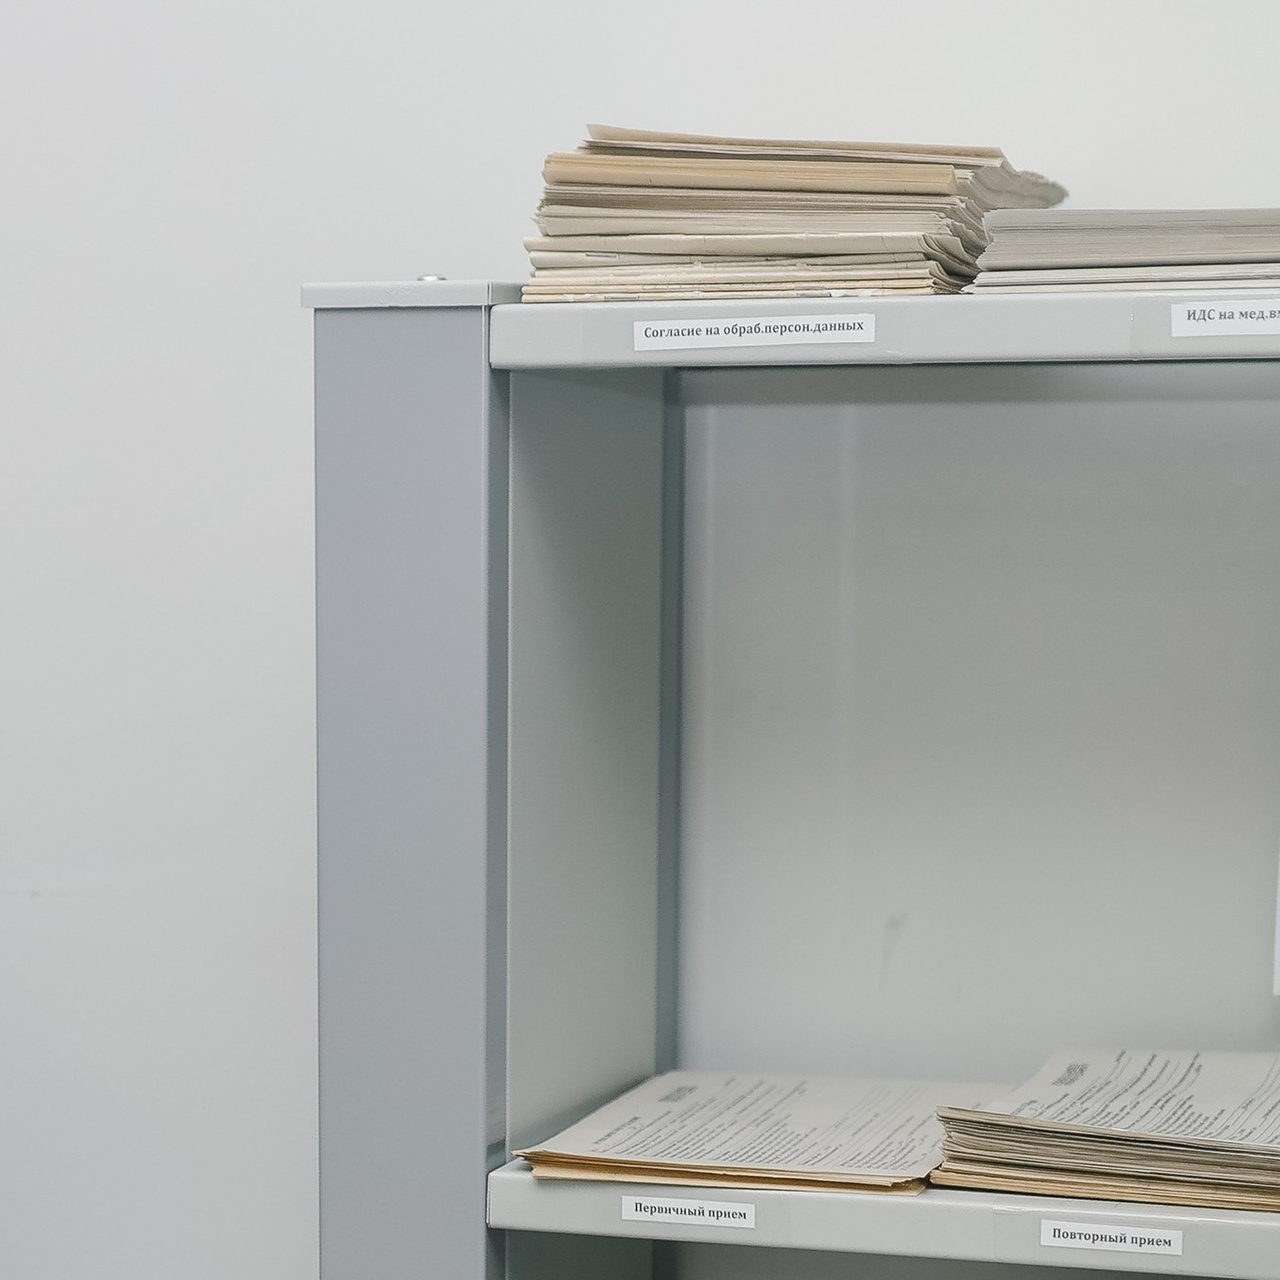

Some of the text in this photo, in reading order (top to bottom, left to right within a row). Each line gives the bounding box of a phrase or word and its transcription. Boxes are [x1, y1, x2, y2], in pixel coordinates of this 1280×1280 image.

[1187, 309, 1216, 322] ИДС
[1219, 310, 1235, 320] на
[644, 320, 864, 338] Согласие на обраб.персон.данных
[634, 1202, 747, 1220] Первичный прием
[1053, 1228, 1172, 1247] Повторный прием
